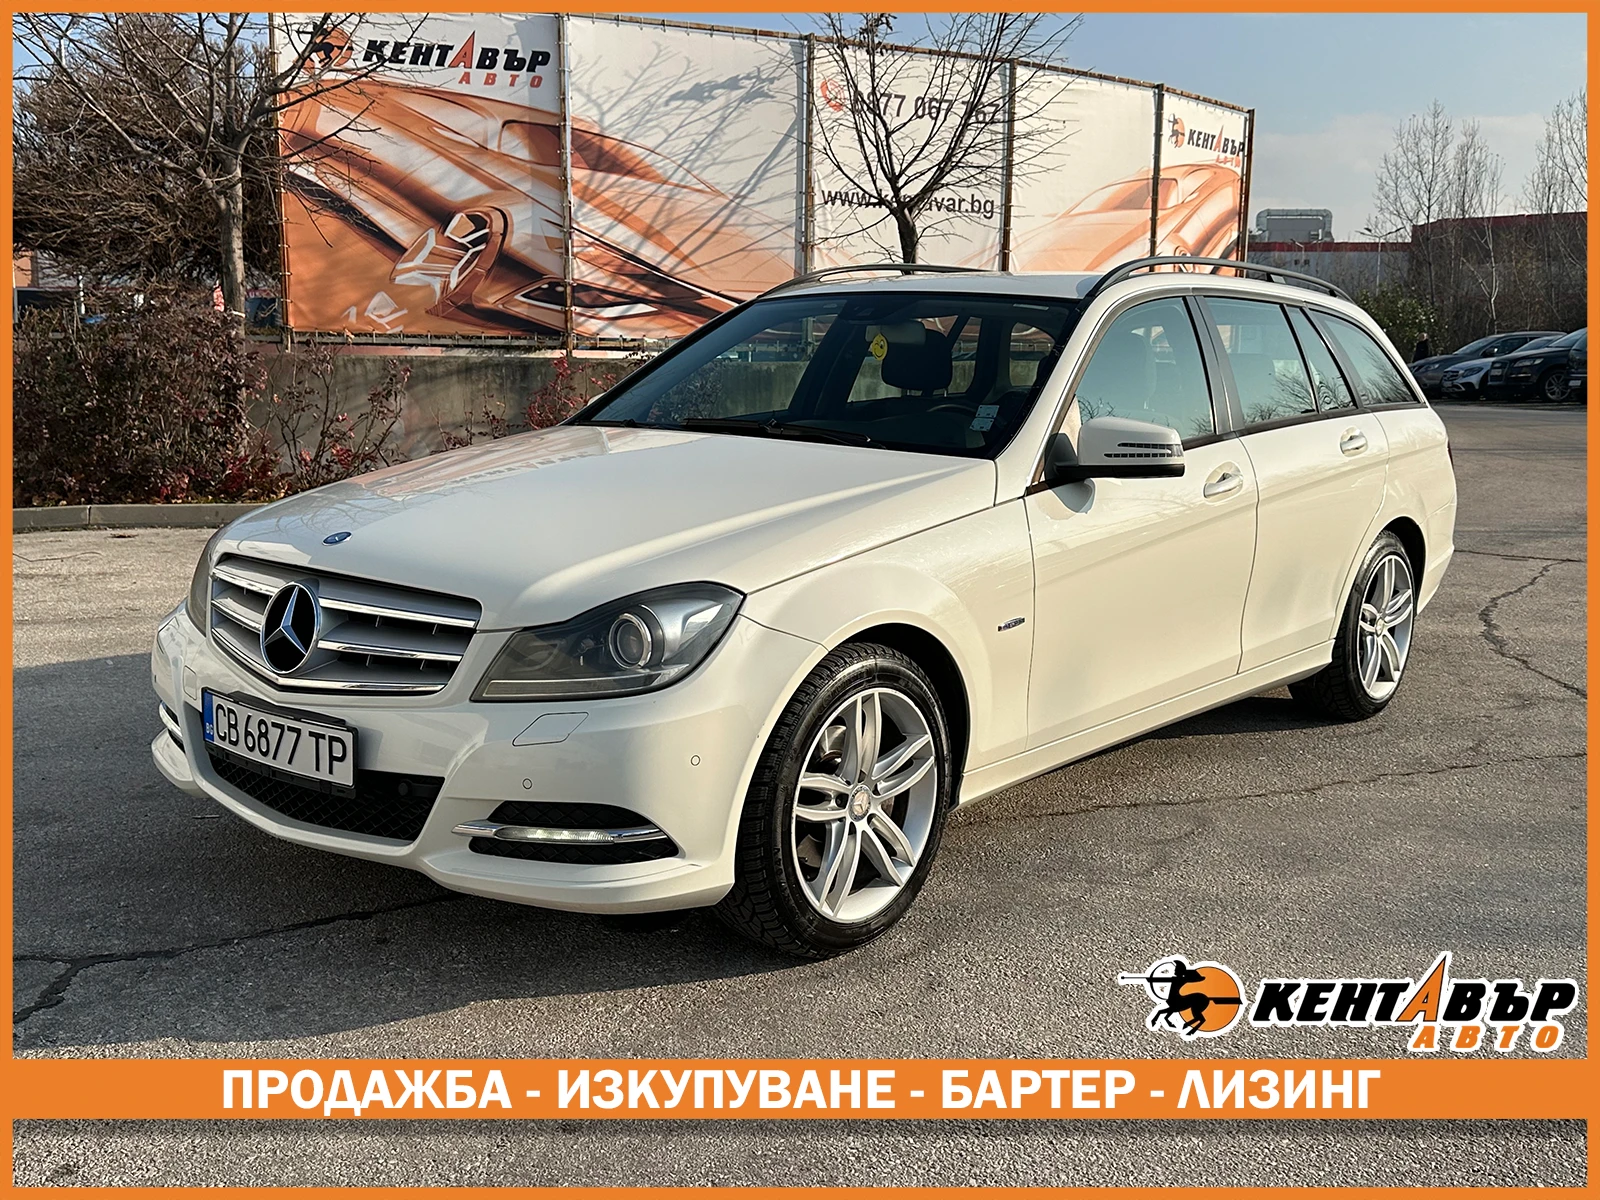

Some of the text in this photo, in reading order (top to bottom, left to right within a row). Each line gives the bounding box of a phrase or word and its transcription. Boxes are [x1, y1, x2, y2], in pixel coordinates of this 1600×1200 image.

[363, 31, 550, 73] КЕНТАВЪР
[458, 71, 543, 89] АВТО
[914, 95, 951, 120] 067
[1187, 124, 1245, 157] КЕНТАВЪР
[244, 715, 301, 765] 6877
